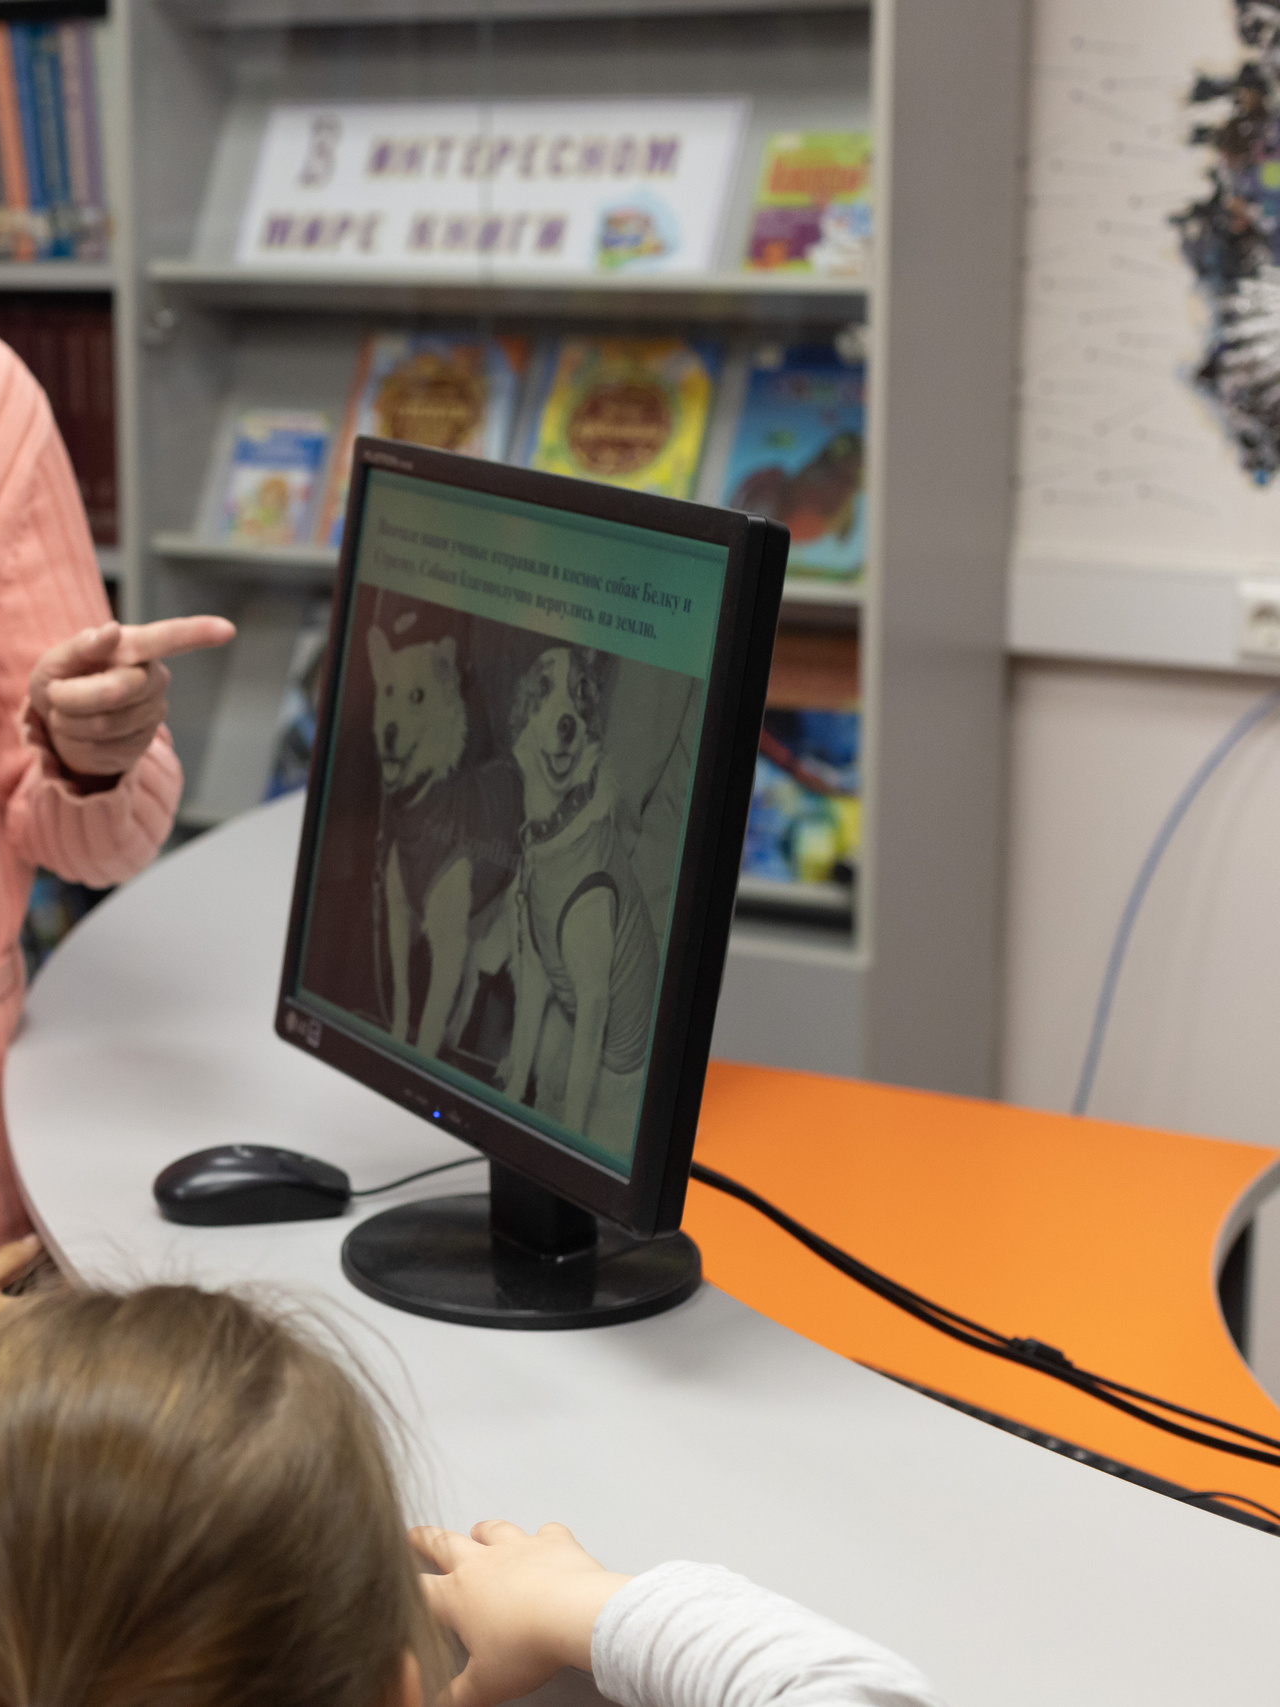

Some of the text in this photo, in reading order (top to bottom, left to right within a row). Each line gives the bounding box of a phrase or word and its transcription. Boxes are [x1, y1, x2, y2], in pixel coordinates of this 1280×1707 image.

[366, 132, 683, 181] ИНТЕРЕСНОМ
[261, 210, 569, 254] МИРЕ КНИГИ
[561, 567, 603, 591] космос
[605, 576, 641, 600] собак
[642, 581, 682, 615] Белку
[682, 597, 693, 614] и
[535, 594, 595, 622] вернулись
[598, 609, 613, 626] на
[616, 615, 657, 639] землю.
